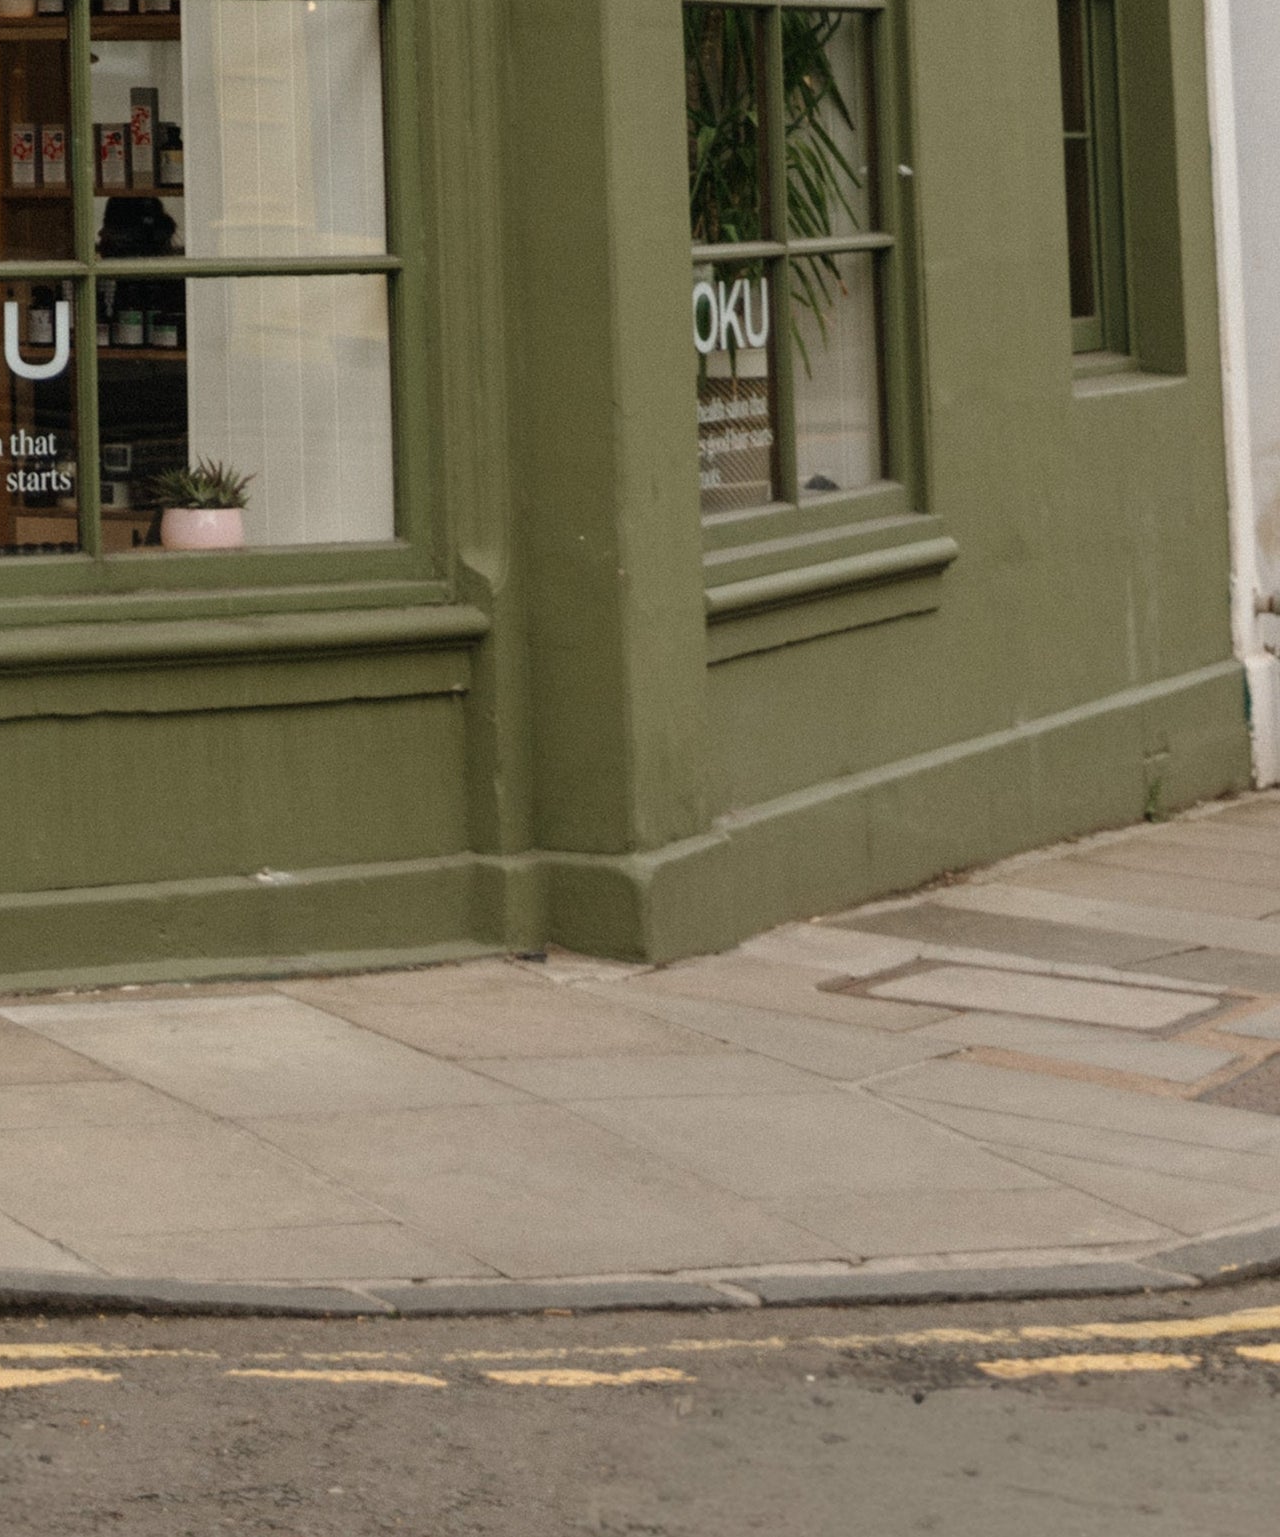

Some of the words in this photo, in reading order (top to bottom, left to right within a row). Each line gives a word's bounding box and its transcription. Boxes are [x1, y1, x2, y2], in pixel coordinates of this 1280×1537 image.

[692, 277, 769, 354] OKU
[10, 428, 57, 456] that
[6, 469, 72, 492] starts
